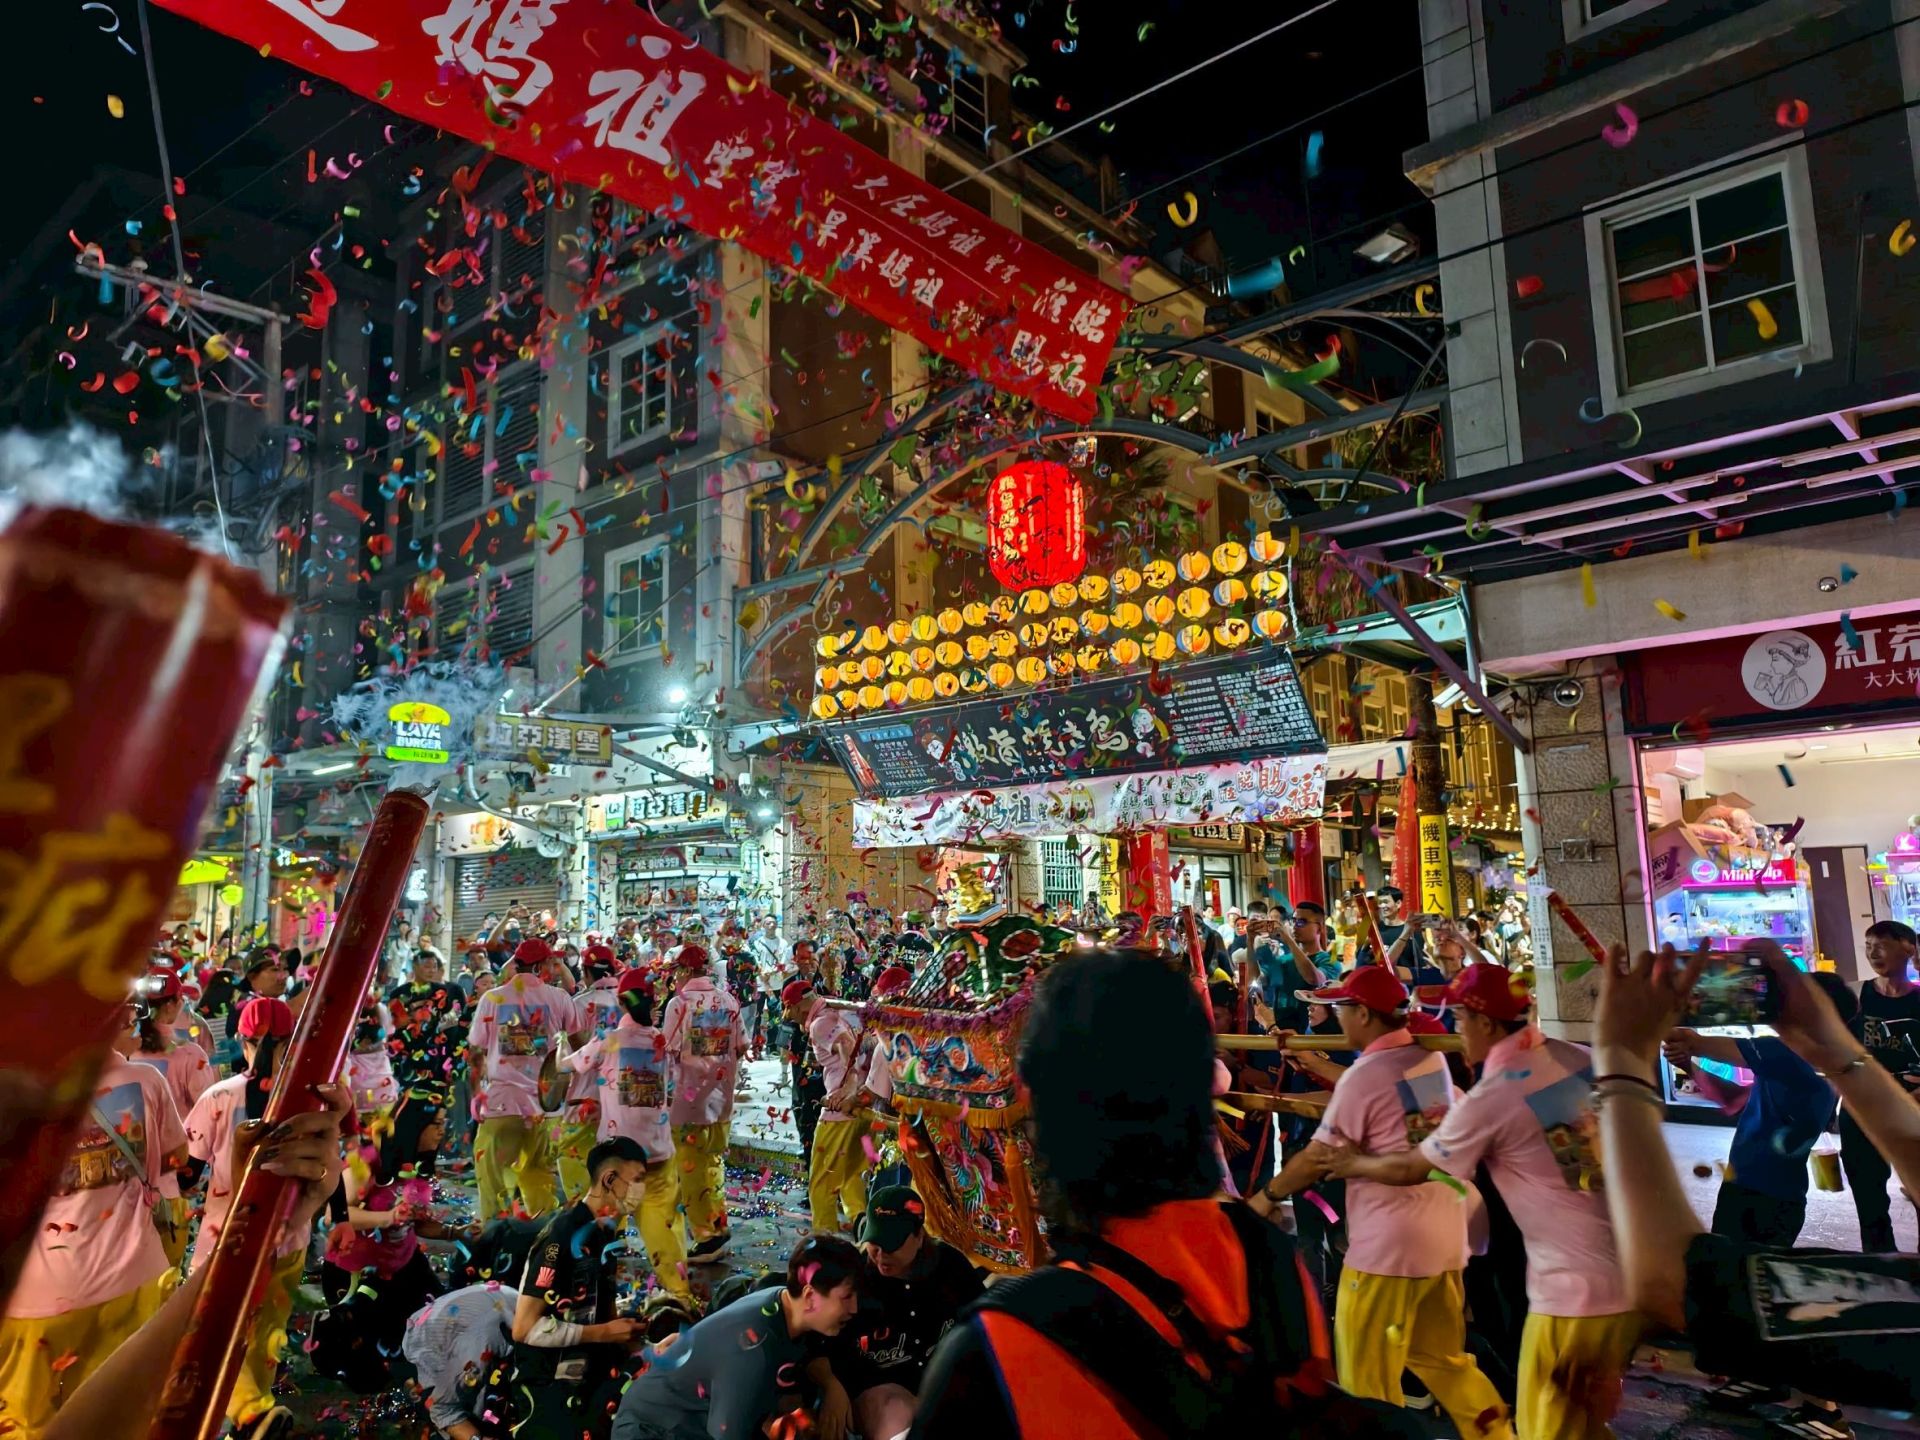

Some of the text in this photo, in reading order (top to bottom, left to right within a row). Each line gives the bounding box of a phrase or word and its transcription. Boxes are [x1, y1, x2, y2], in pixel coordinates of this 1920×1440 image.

[487, 722, 602, 753] 拉亞漢堡
[1422, 822, 1445, 912] 機車禁入
